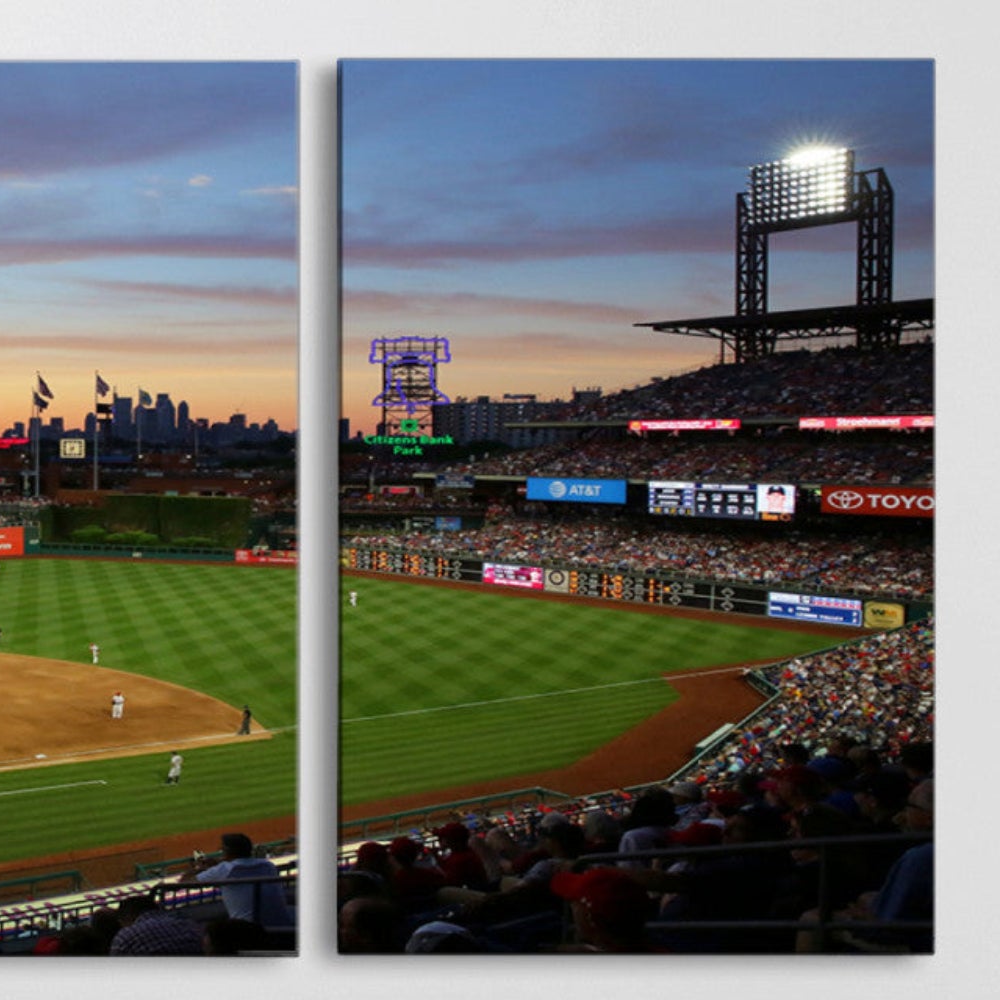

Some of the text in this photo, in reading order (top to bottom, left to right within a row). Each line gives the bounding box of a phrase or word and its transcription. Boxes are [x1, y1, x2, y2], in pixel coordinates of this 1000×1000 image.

[363, 434, 454, 445] Citizens Bank
[393, 445, 423, 455] Park
[569, 485, 601, 497] AT&T
